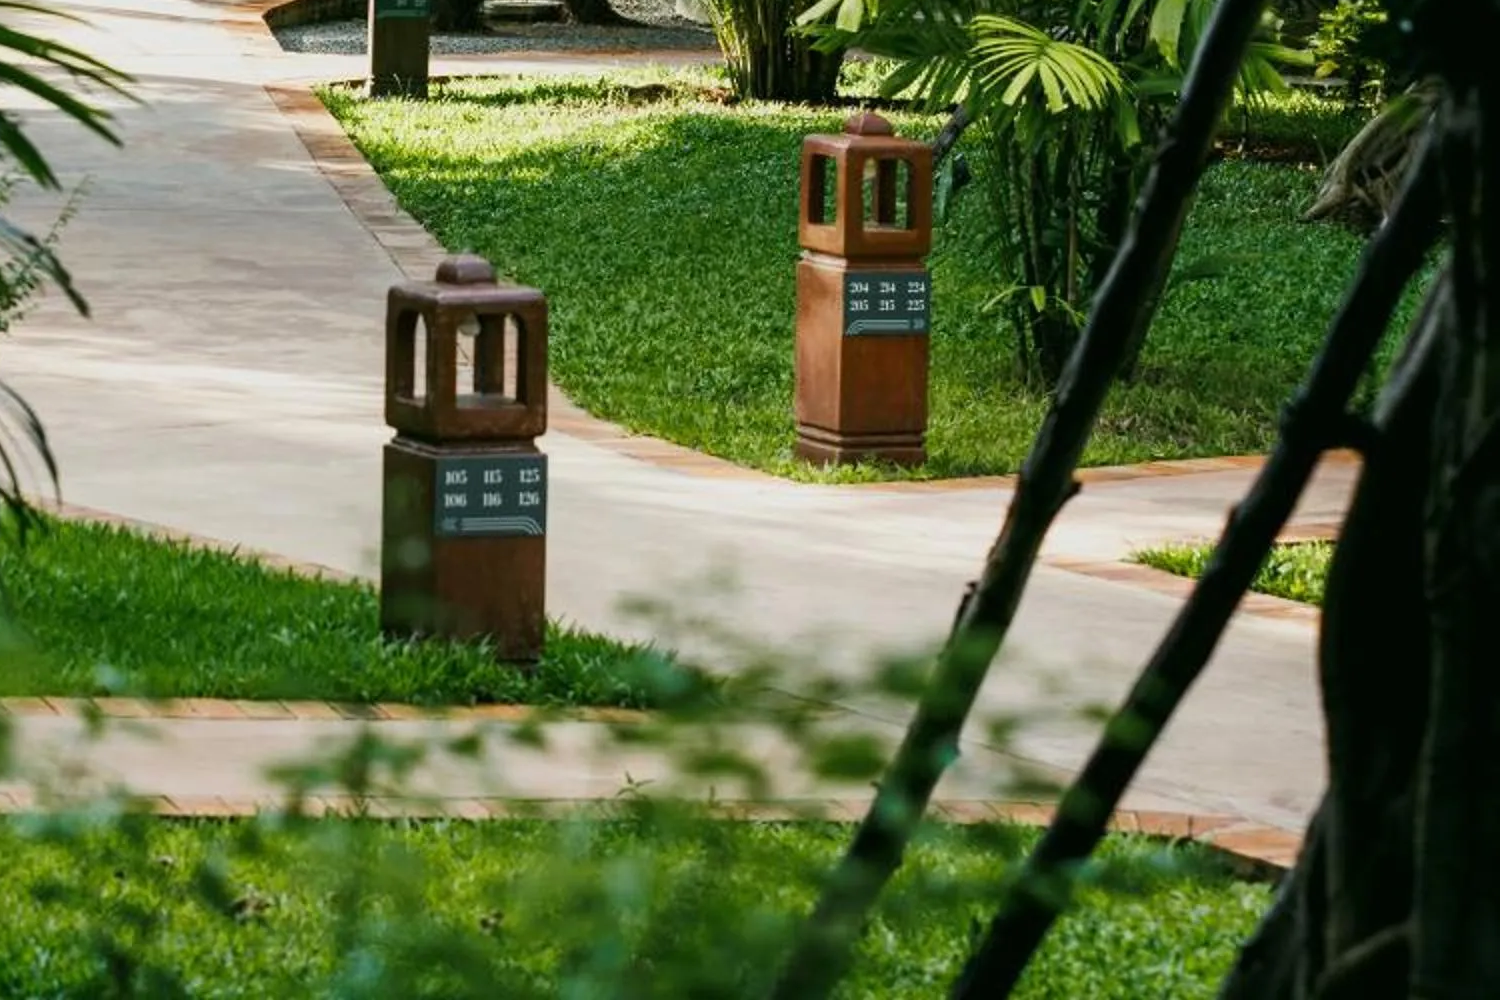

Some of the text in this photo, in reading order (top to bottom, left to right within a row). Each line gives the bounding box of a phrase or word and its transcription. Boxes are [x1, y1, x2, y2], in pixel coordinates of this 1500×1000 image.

[849, 282, 869, 293] 204
[878, 299, 895, 311] 215
[906, 299, 925, 311] 225
[445, 468, 541, 485] 105 115 125
[444, 491, 540, 508] 106 116 126
